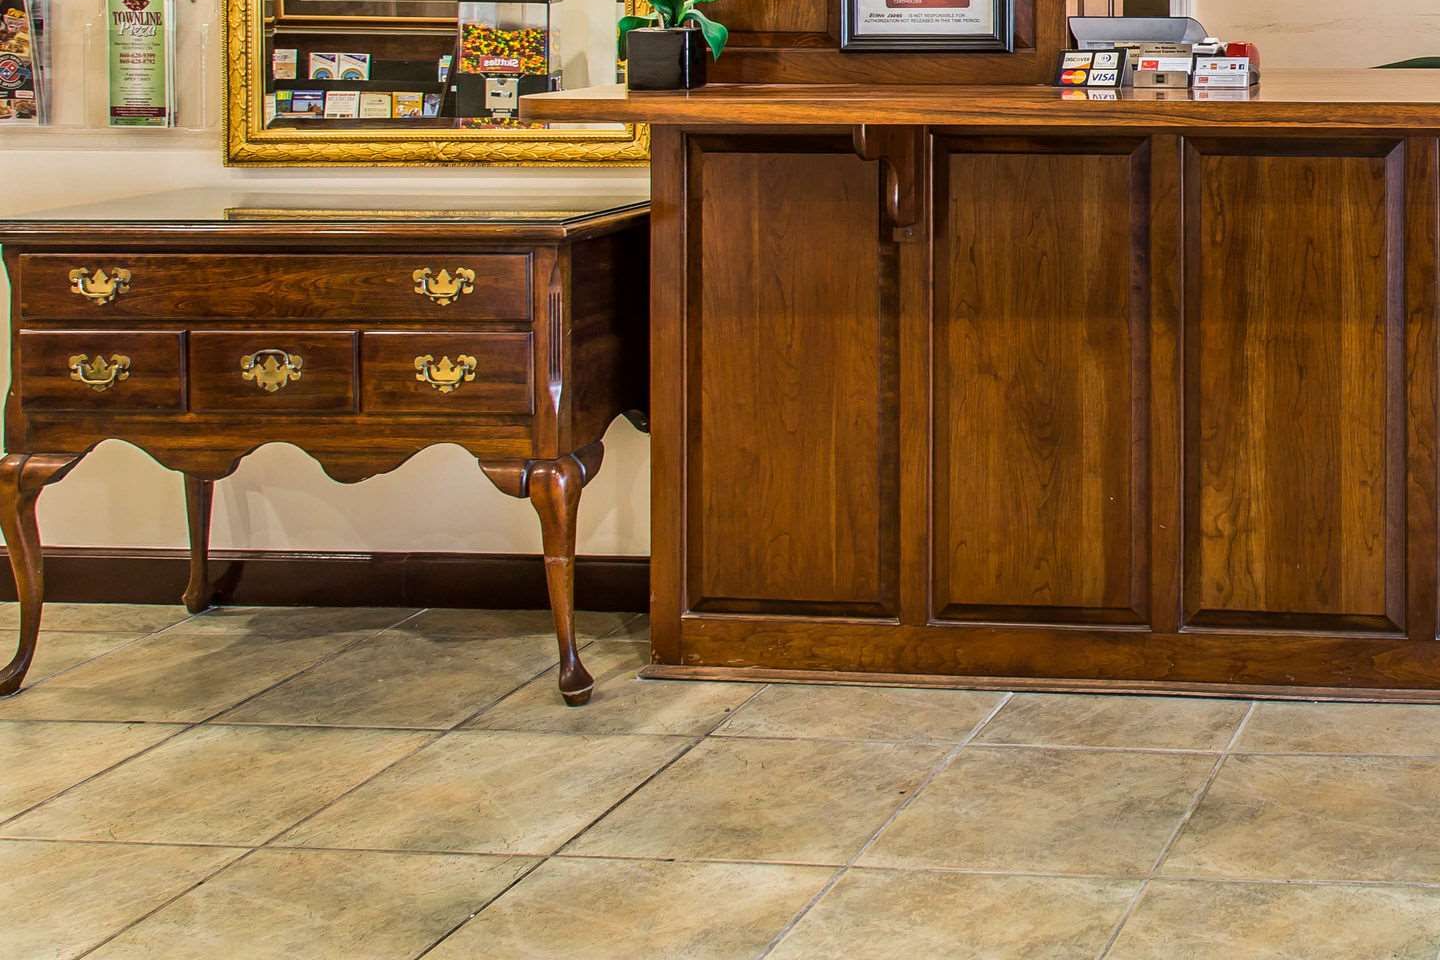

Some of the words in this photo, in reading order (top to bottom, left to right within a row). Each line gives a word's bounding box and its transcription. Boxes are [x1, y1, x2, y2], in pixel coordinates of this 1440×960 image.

[112, 11, 162, 26] TOWNLINE
[119, 22, 157, 37] Pizza
[1092, 73, 1116, 81] VISA
